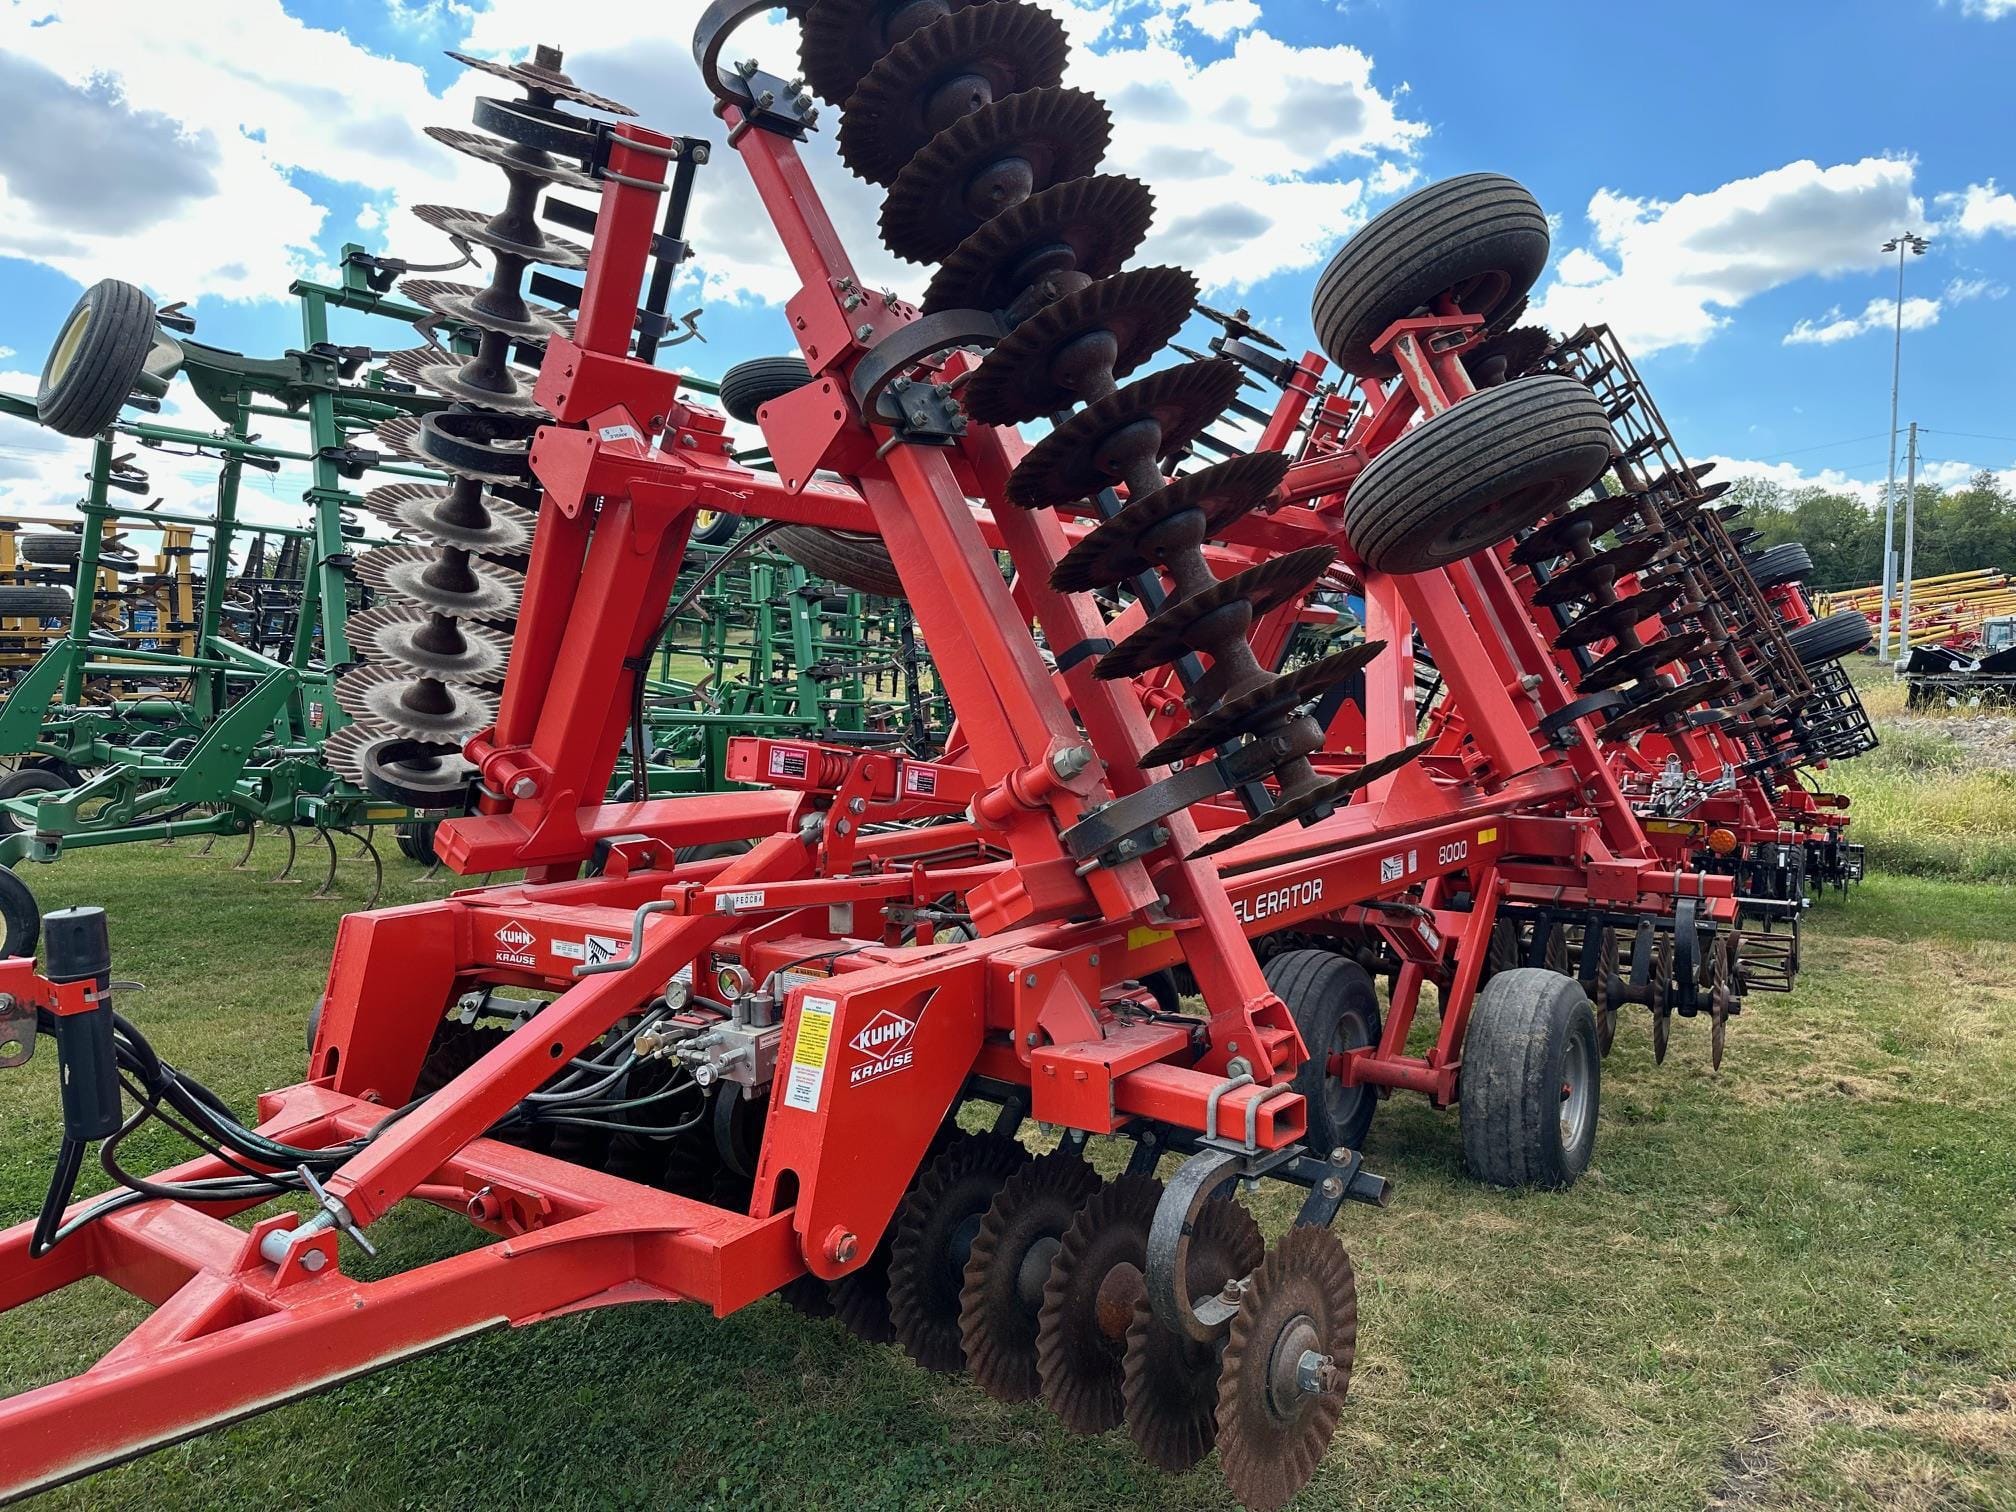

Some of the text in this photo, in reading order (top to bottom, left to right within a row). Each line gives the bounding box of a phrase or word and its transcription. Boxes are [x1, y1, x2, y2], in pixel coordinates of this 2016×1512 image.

[1438, 839, 1468, 866] 8000
[499, 929, 531, 945] KUHN
[495, 952, 536, 966] KRAUSE
[859, 1019, 907, 1050] KUHN
[850, 1051, 914, 1083] KRAUSE
